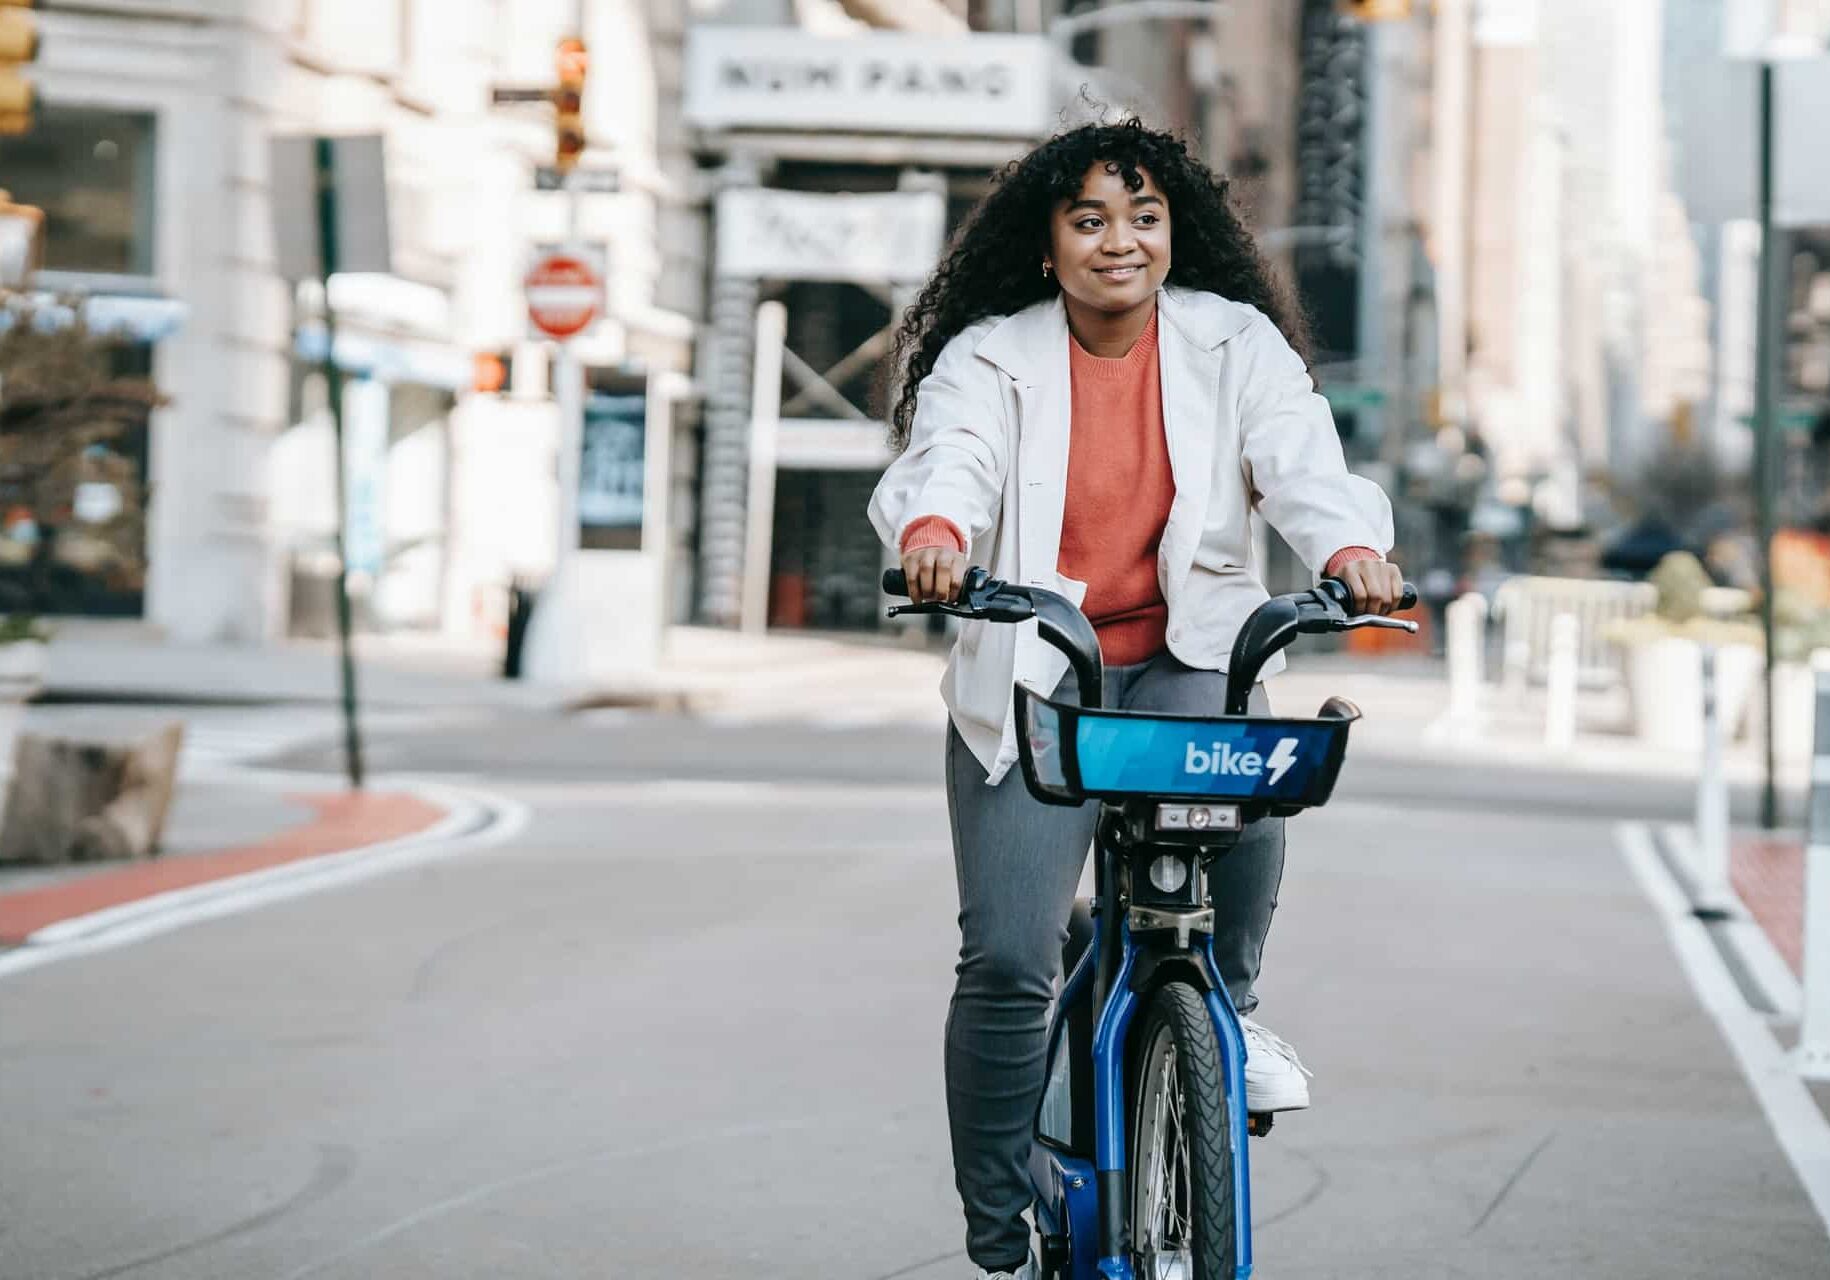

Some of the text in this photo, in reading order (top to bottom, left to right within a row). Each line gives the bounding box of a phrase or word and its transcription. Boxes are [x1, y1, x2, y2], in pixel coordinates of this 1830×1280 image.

[718, 58, 1012, 97] NUM PANG
[1185, 741, 1263, 776] bike
